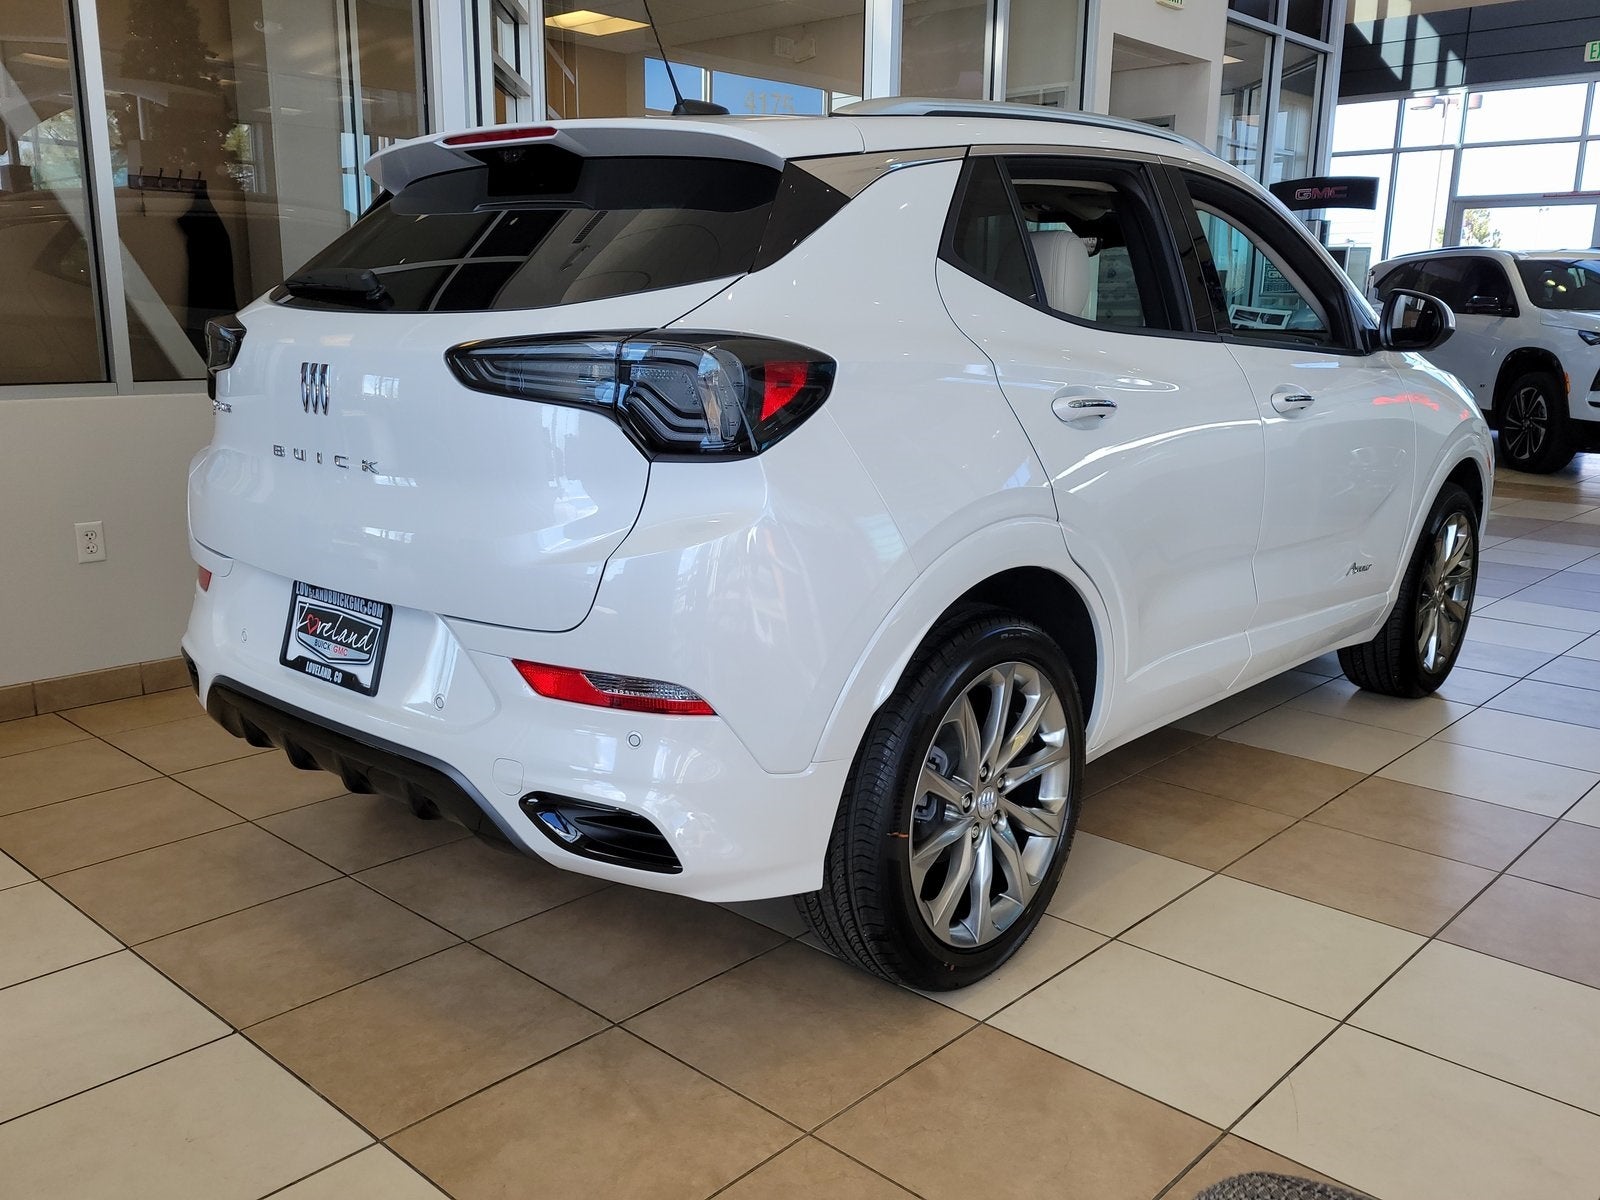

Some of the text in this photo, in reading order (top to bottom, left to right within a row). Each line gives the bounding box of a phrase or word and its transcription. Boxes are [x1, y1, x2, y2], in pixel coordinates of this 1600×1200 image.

[1295, 186, 1348, 200] GMC
[273, 444, 380, 475] BUICK
[295, 581, 385, 618] LOVELANDBUICKGMC.COM
[314, 639, 349, 657] BUICK GMC
[305, 661, 343, 684] LOVELAND, CO
